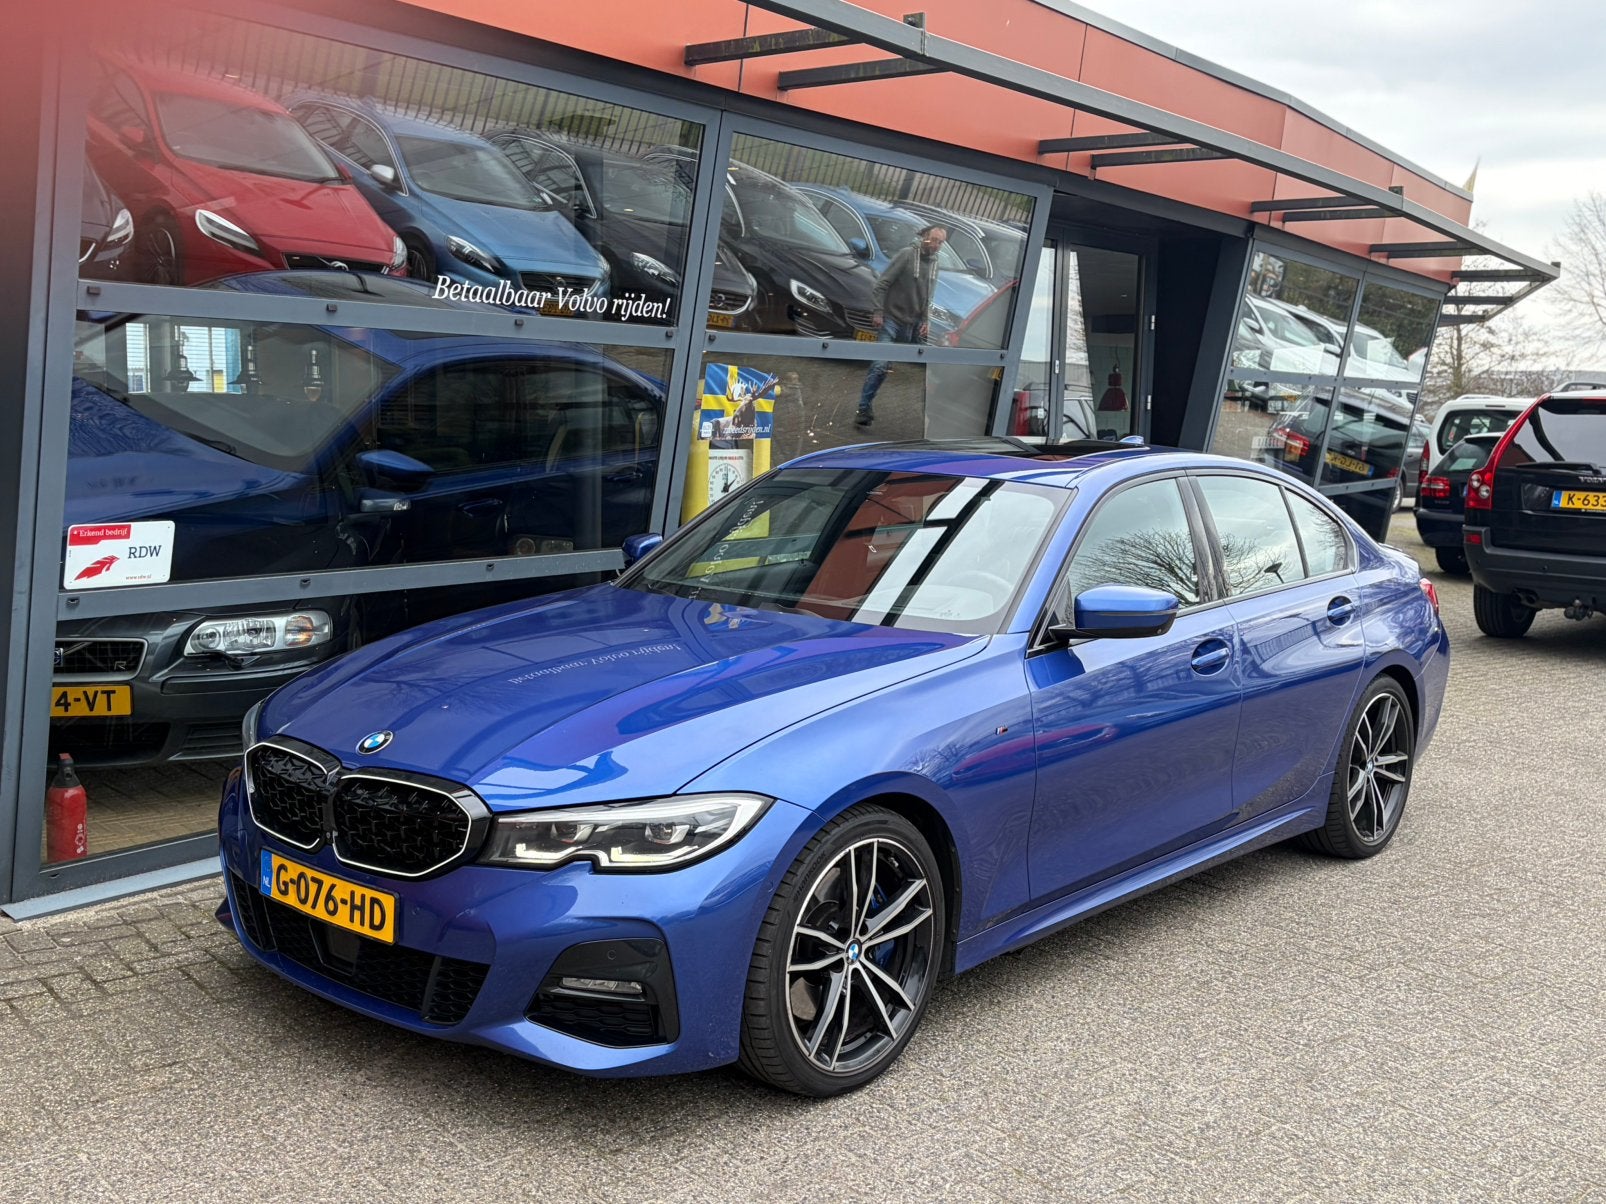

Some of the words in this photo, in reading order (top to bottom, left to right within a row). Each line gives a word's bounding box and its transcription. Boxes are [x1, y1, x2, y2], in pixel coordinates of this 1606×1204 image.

[432, 275, 551, 308] Betaalbaar
[557, 286, 608, 314] Volvo
[611, 292, 671, 321] rijden!
[79, 529, 104, 537] Erkend
[105, 528, 128, 536] bedrijf
[128, 545, 162, 559] RDW
[113, 660, 126, 671] R
[54, 689, 117, 713] 4-VT
[275, 863, 387, 932] G-076-HD
